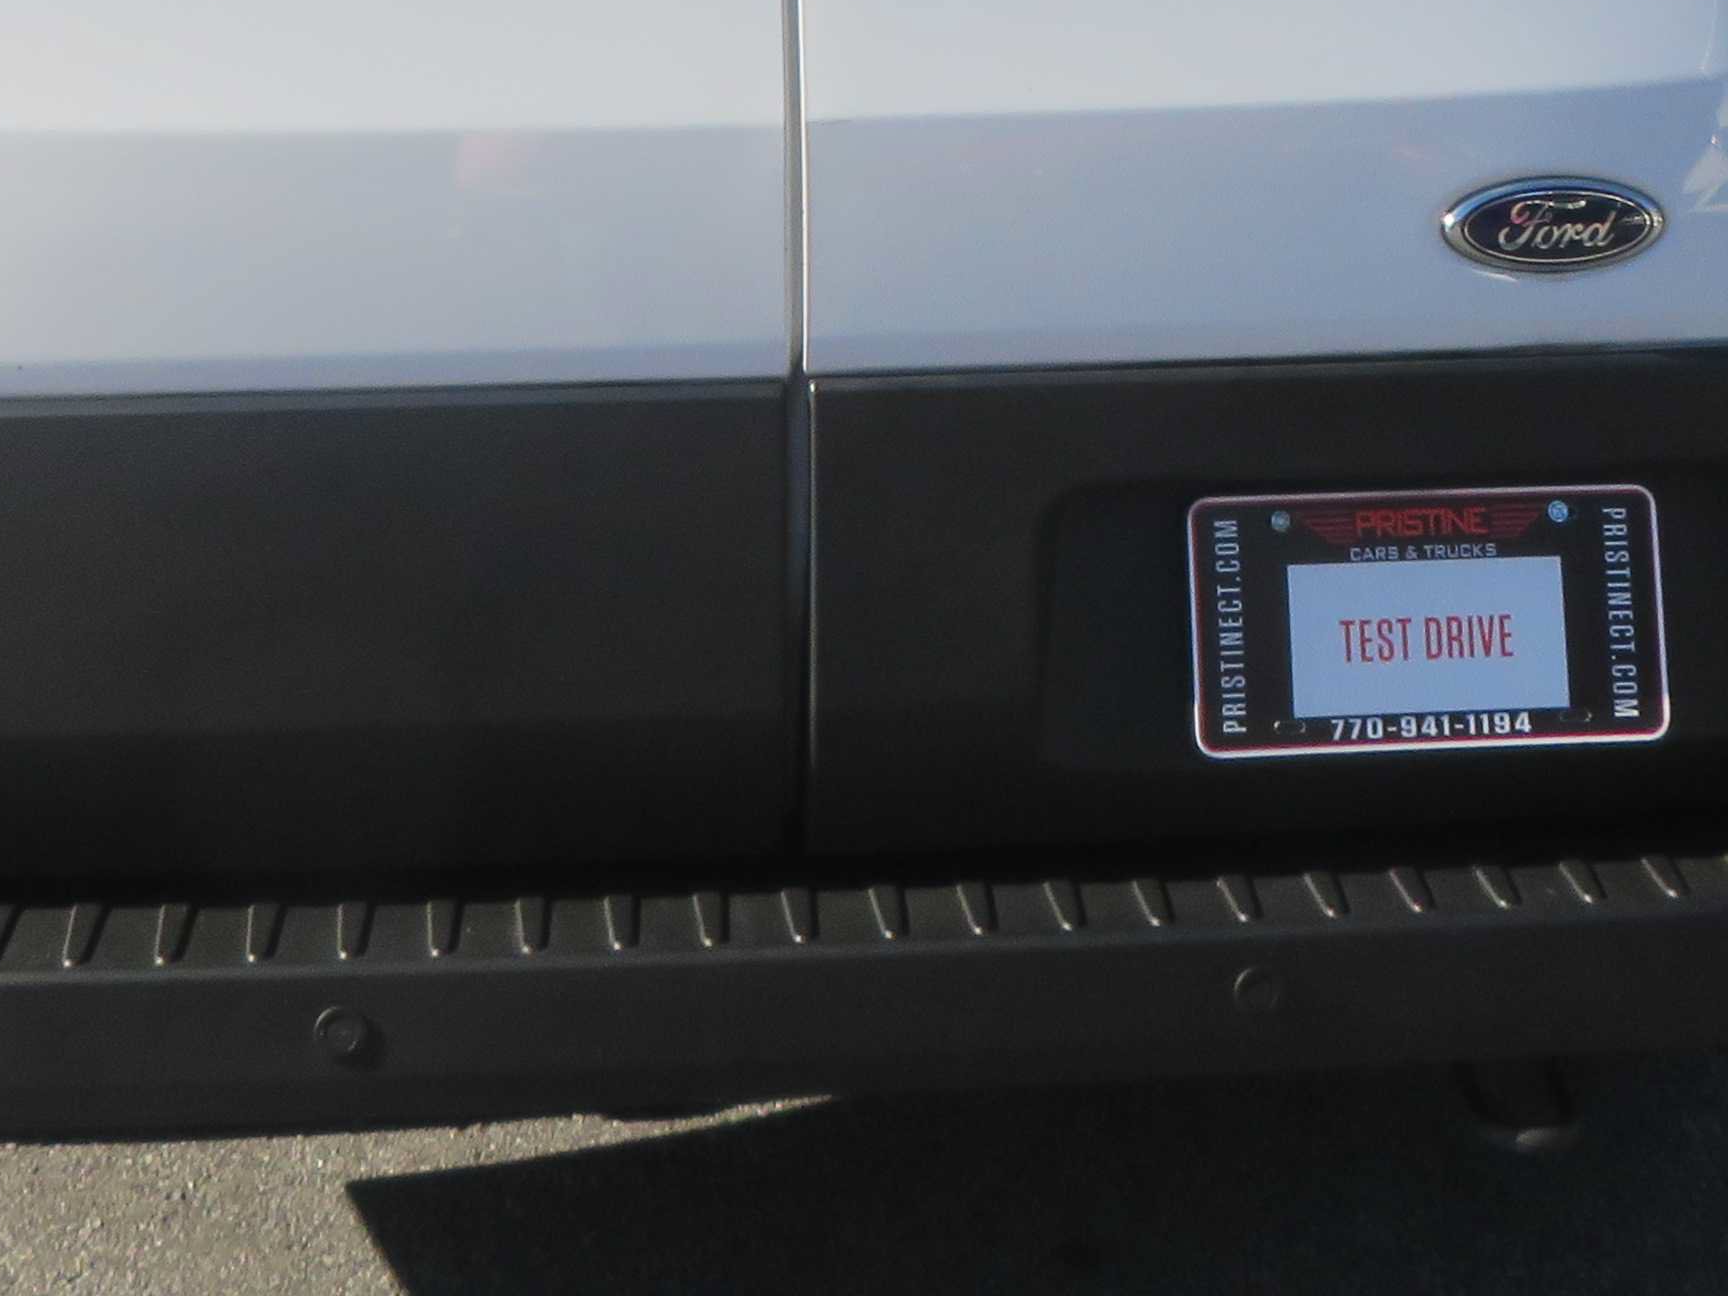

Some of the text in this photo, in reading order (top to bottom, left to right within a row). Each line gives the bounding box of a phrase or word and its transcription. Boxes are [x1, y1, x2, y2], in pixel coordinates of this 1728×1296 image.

[1497, 199, 1618, 251] Ford
[1354, 505, 1490, 538] PRISTINE
[1349, 542, 1498, 562] CARS & TRUCKS
[1213, 519, 1248, 735] PRISTINECT.COM
[1602, 507, 1641, 718] PRISTINECT.COM
[1338, 613, 1515, 663] TEST DRIVE
[1330, 710, 1533, 742] 770-941-1194
